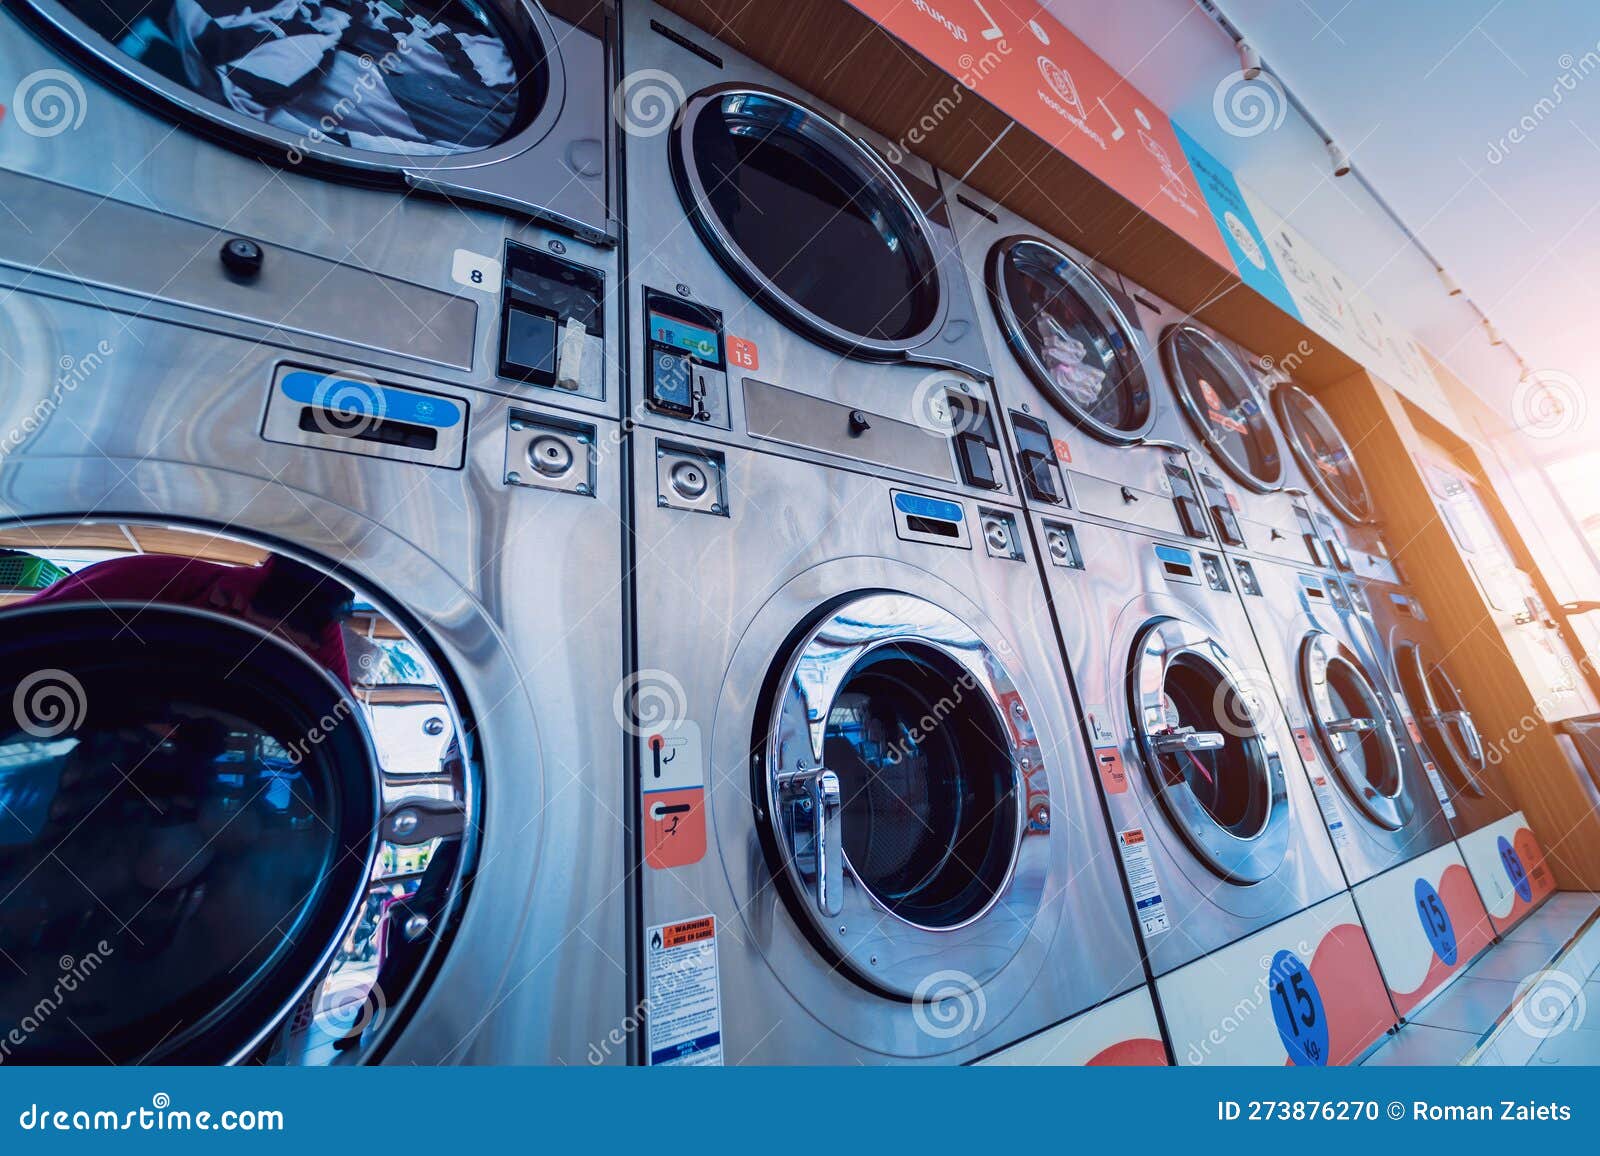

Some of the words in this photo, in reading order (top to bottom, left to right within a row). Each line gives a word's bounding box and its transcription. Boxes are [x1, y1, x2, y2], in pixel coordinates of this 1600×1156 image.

[470, 269, 483, 284] 8
[735, 350, 752, 366] 15
[1419, 893, 1446, 938] 15
[675, 919, 710, 933] WARNING
[1276, 972, 1316, 1037] 15
